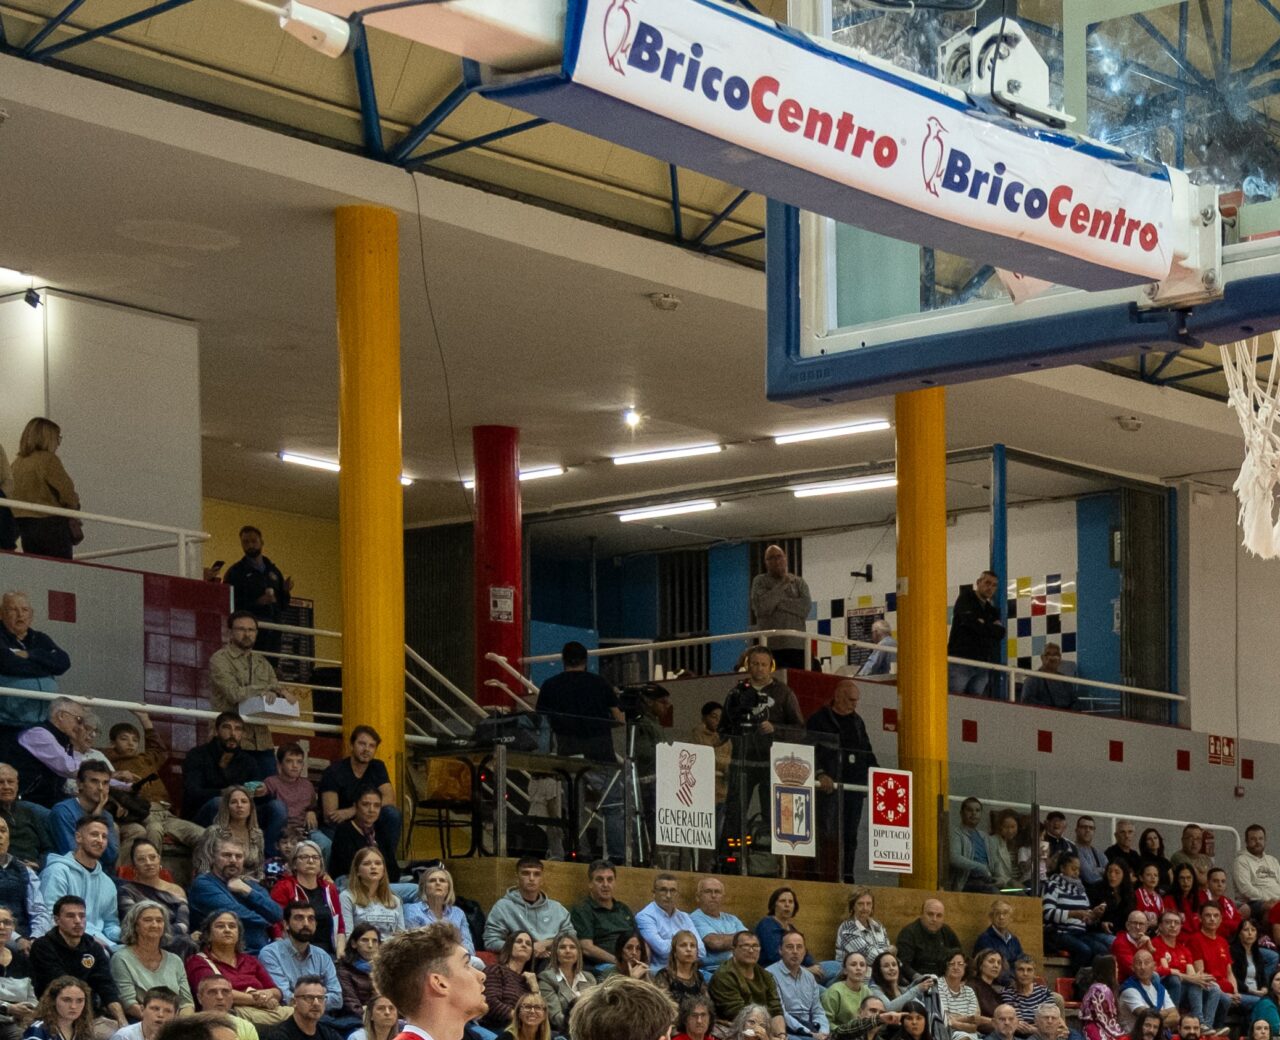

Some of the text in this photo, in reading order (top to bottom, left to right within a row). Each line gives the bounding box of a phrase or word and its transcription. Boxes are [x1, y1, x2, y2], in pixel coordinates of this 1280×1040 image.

[627, 21, 898, 169] BricoCentro
[941, 147, 1159, 252] BricoCentro
[658, 808, 713, 829] GENERALITAT
[660, 826, 713, 847] VALENCIANA
[873, 829, 910, 840] DIPUTACIÓ
[873, 850, 910, 860] CASTELLÓ
